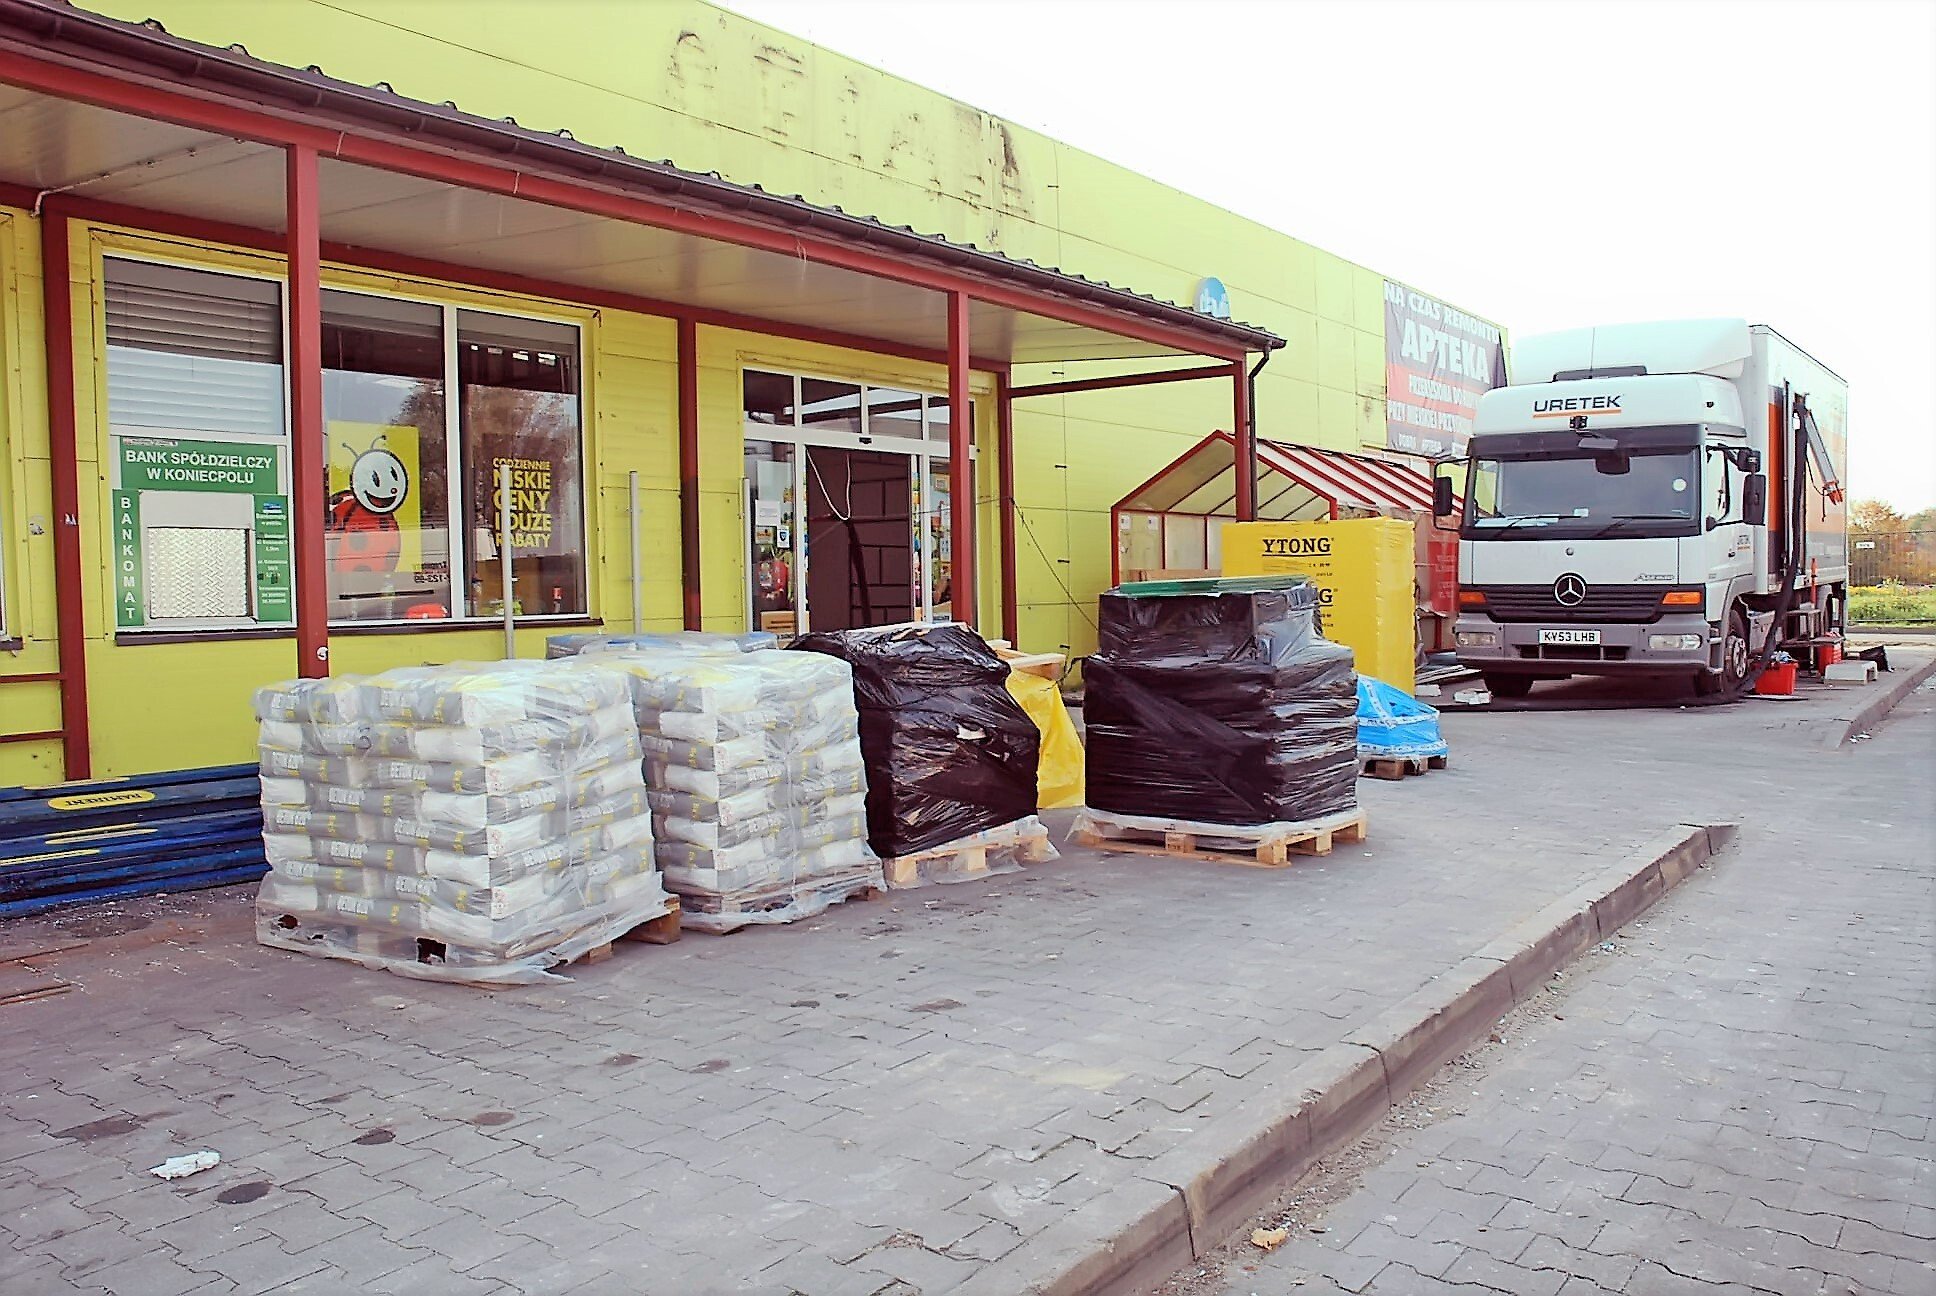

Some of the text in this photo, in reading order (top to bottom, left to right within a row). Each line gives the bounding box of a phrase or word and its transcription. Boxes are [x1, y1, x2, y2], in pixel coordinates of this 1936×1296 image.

[1401, 319, 1490, 385] APTEKA
[1534, 395, 1621, 412] URETEK
[125, 450, 273, 468] BANK SPÓŁDZIELCZY
[147, 468, 255, 483] W KONIECPOLU
[1262, 537, 1332, 554] YTONG
[120, 497, 137, 619] BANKOMAT
[1544, 631, 1595, 642] KY53 LHB
